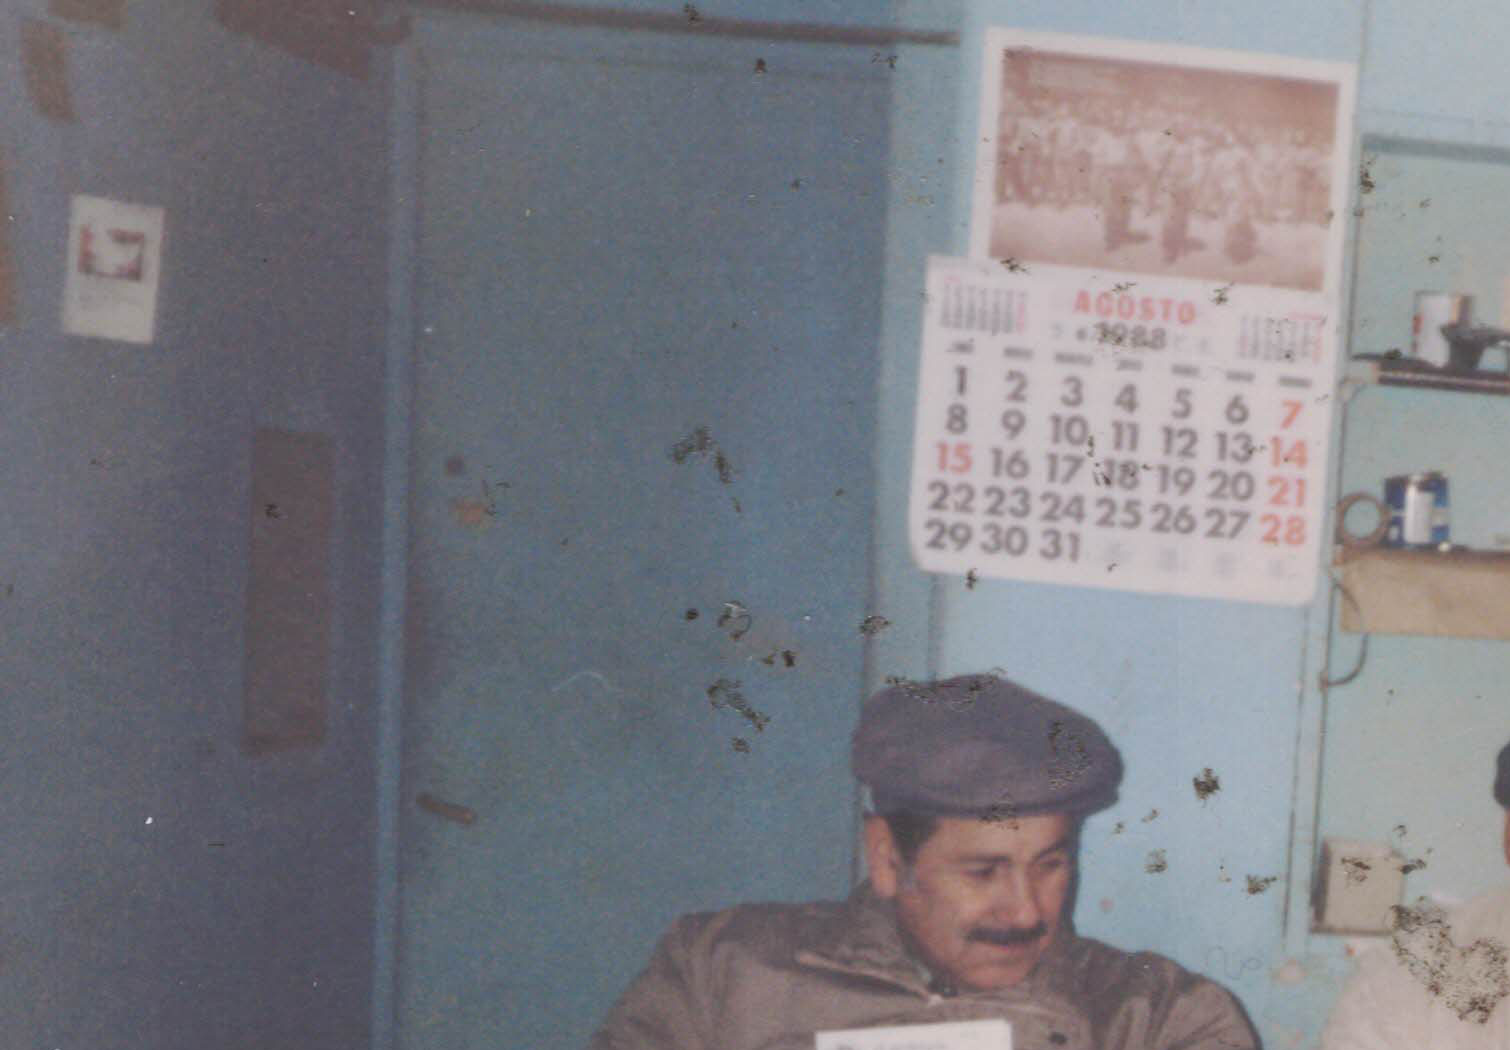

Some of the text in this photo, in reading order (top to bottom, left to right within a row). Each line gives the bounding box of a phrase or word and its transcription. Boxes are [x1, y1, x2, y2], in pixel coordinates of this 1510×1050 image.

[1072, 290, 1197, 326] AGOSTO
[955, 365, 1303, 430] 1 2 3 4 5 6 7
[945, 402, 1309, 469] 8 9 10 11 12 13 14
[936, 441, 1307, 508] 15 16 17 18 19 20 21
[924, 521, 973, 551] 29
[980, 523, 1029, 557] 30
[1039, 529, 1081, 563] 31
[928, 479, 1307, 547] 22 23 24 25 26 27 28
